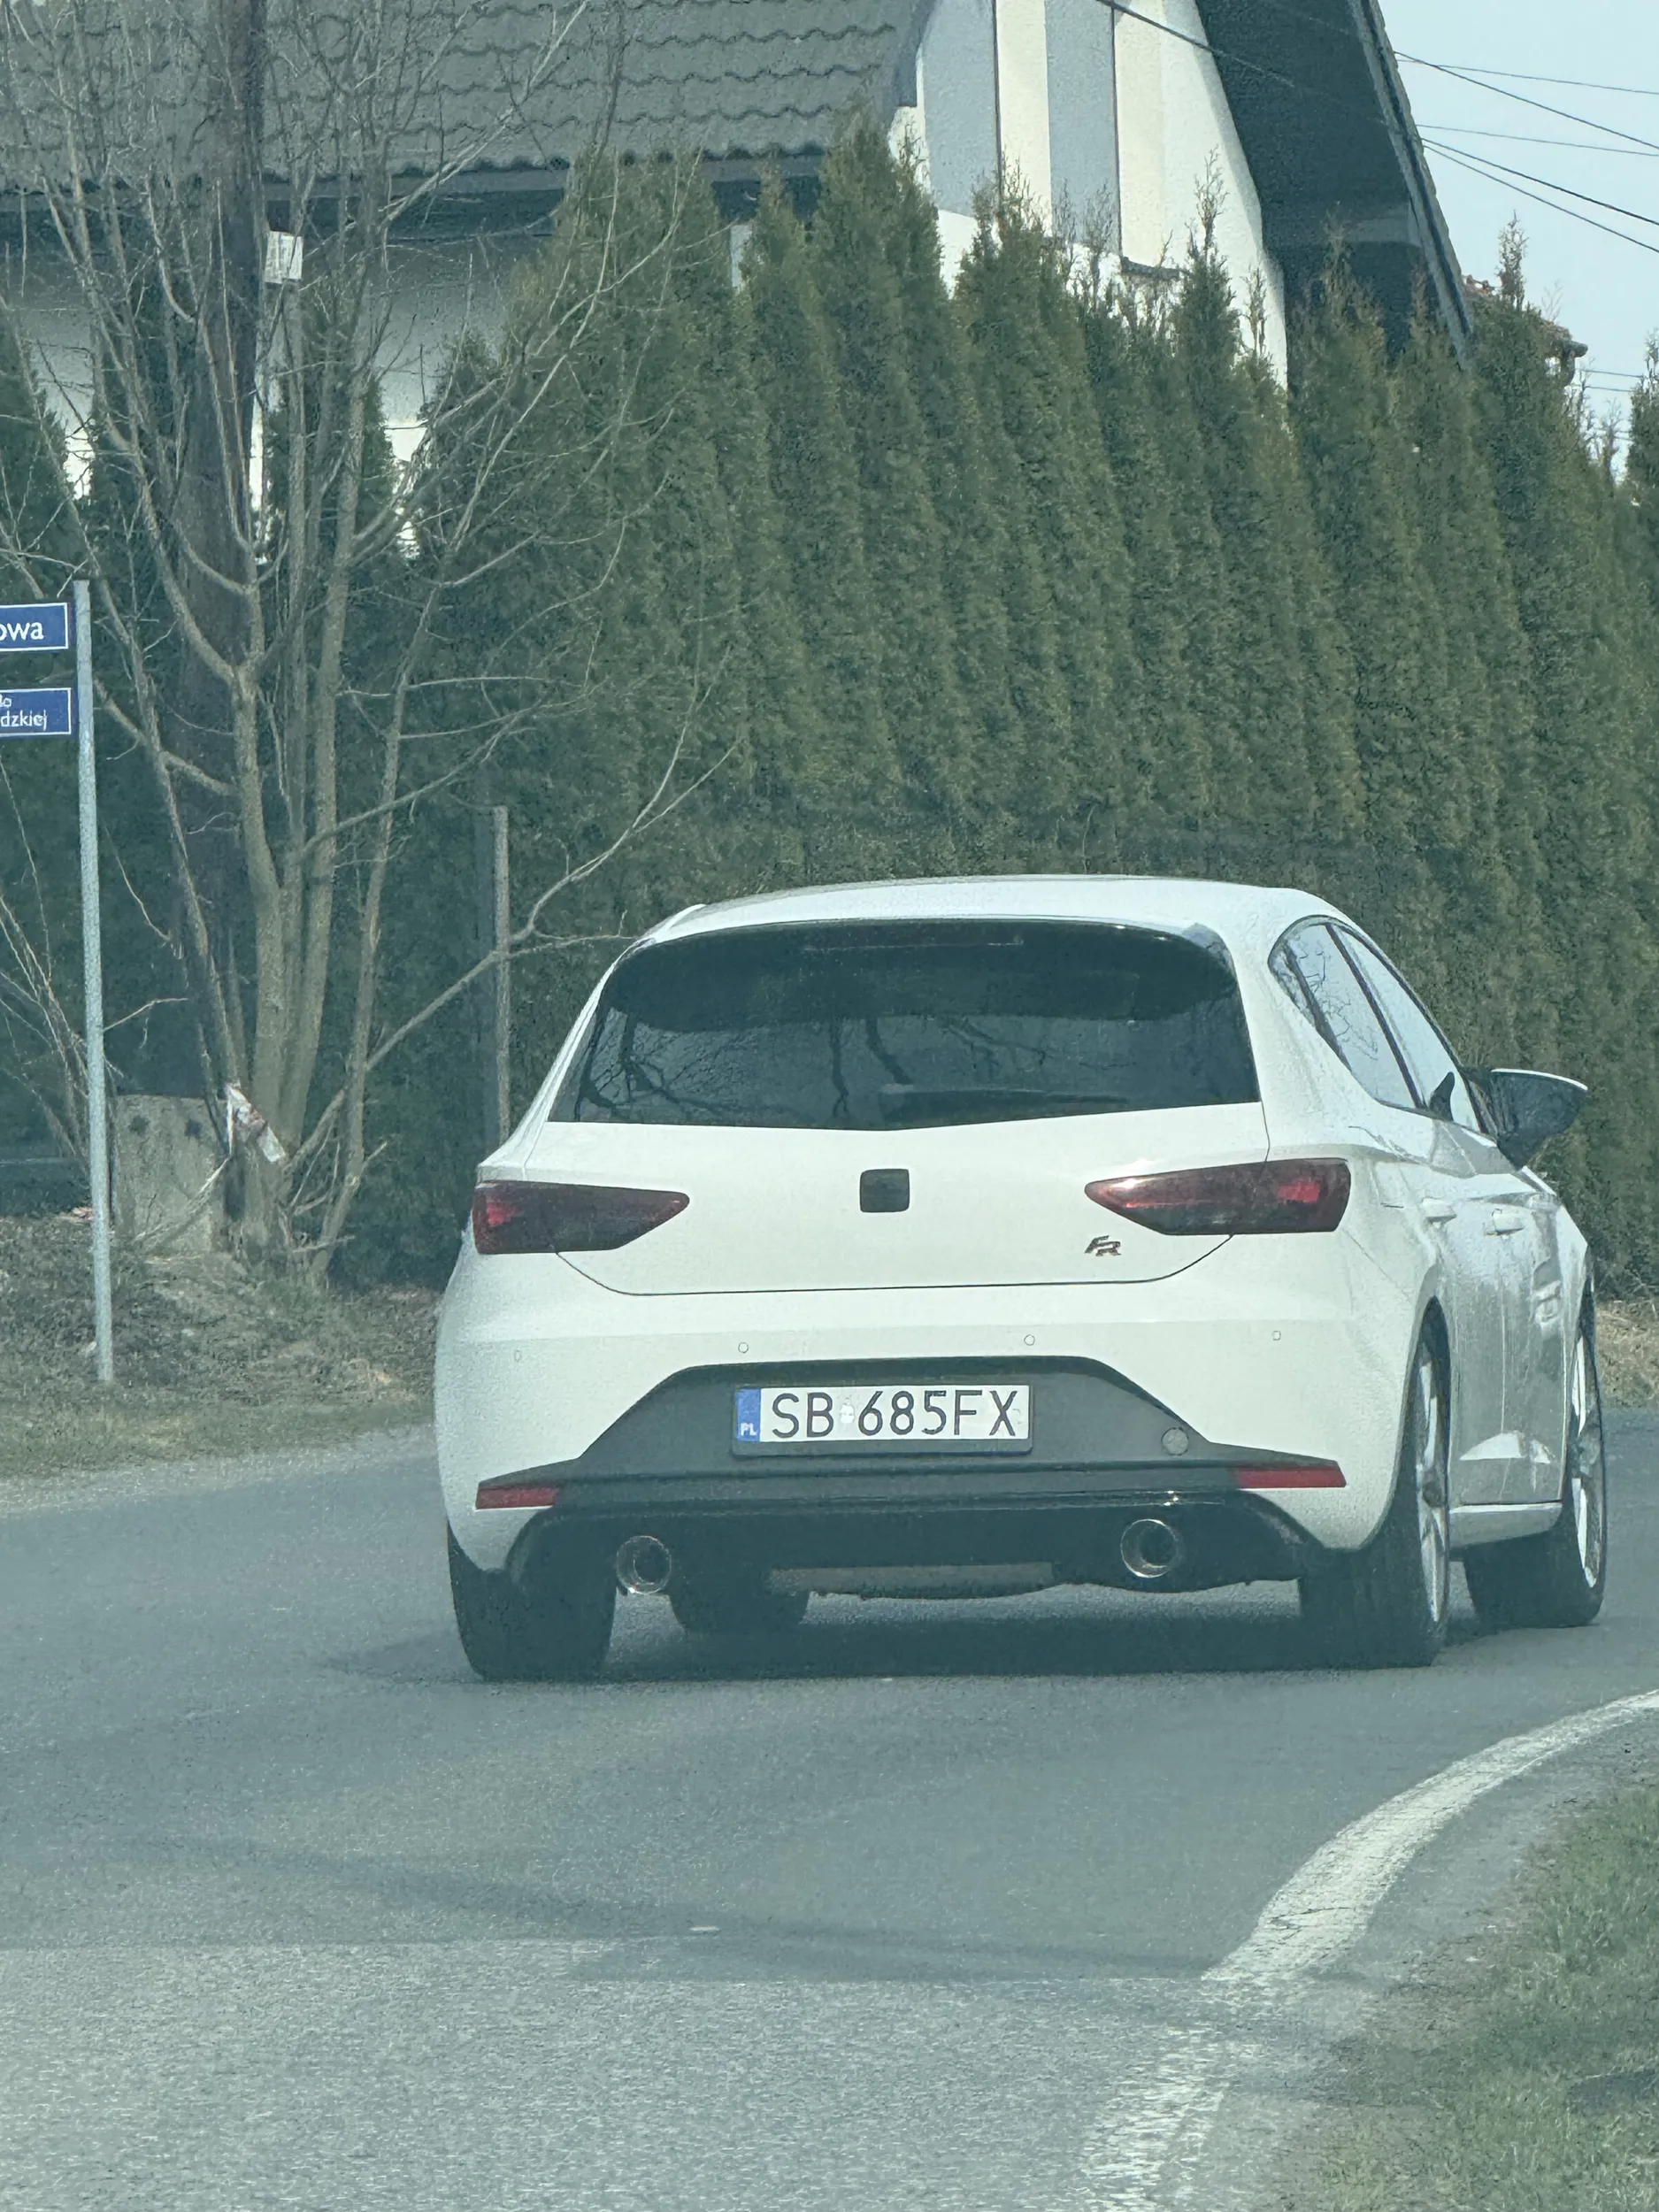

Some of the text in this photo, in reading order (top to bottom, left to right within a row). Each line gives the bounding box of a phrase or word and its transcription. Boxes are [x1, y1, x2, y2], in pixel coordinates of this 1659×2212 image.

[1084, 1235, 1121, 1256] FR
[772, 1390, 1018, 1438] SB 685FX
[740, 1422, 757, 1436] PL
